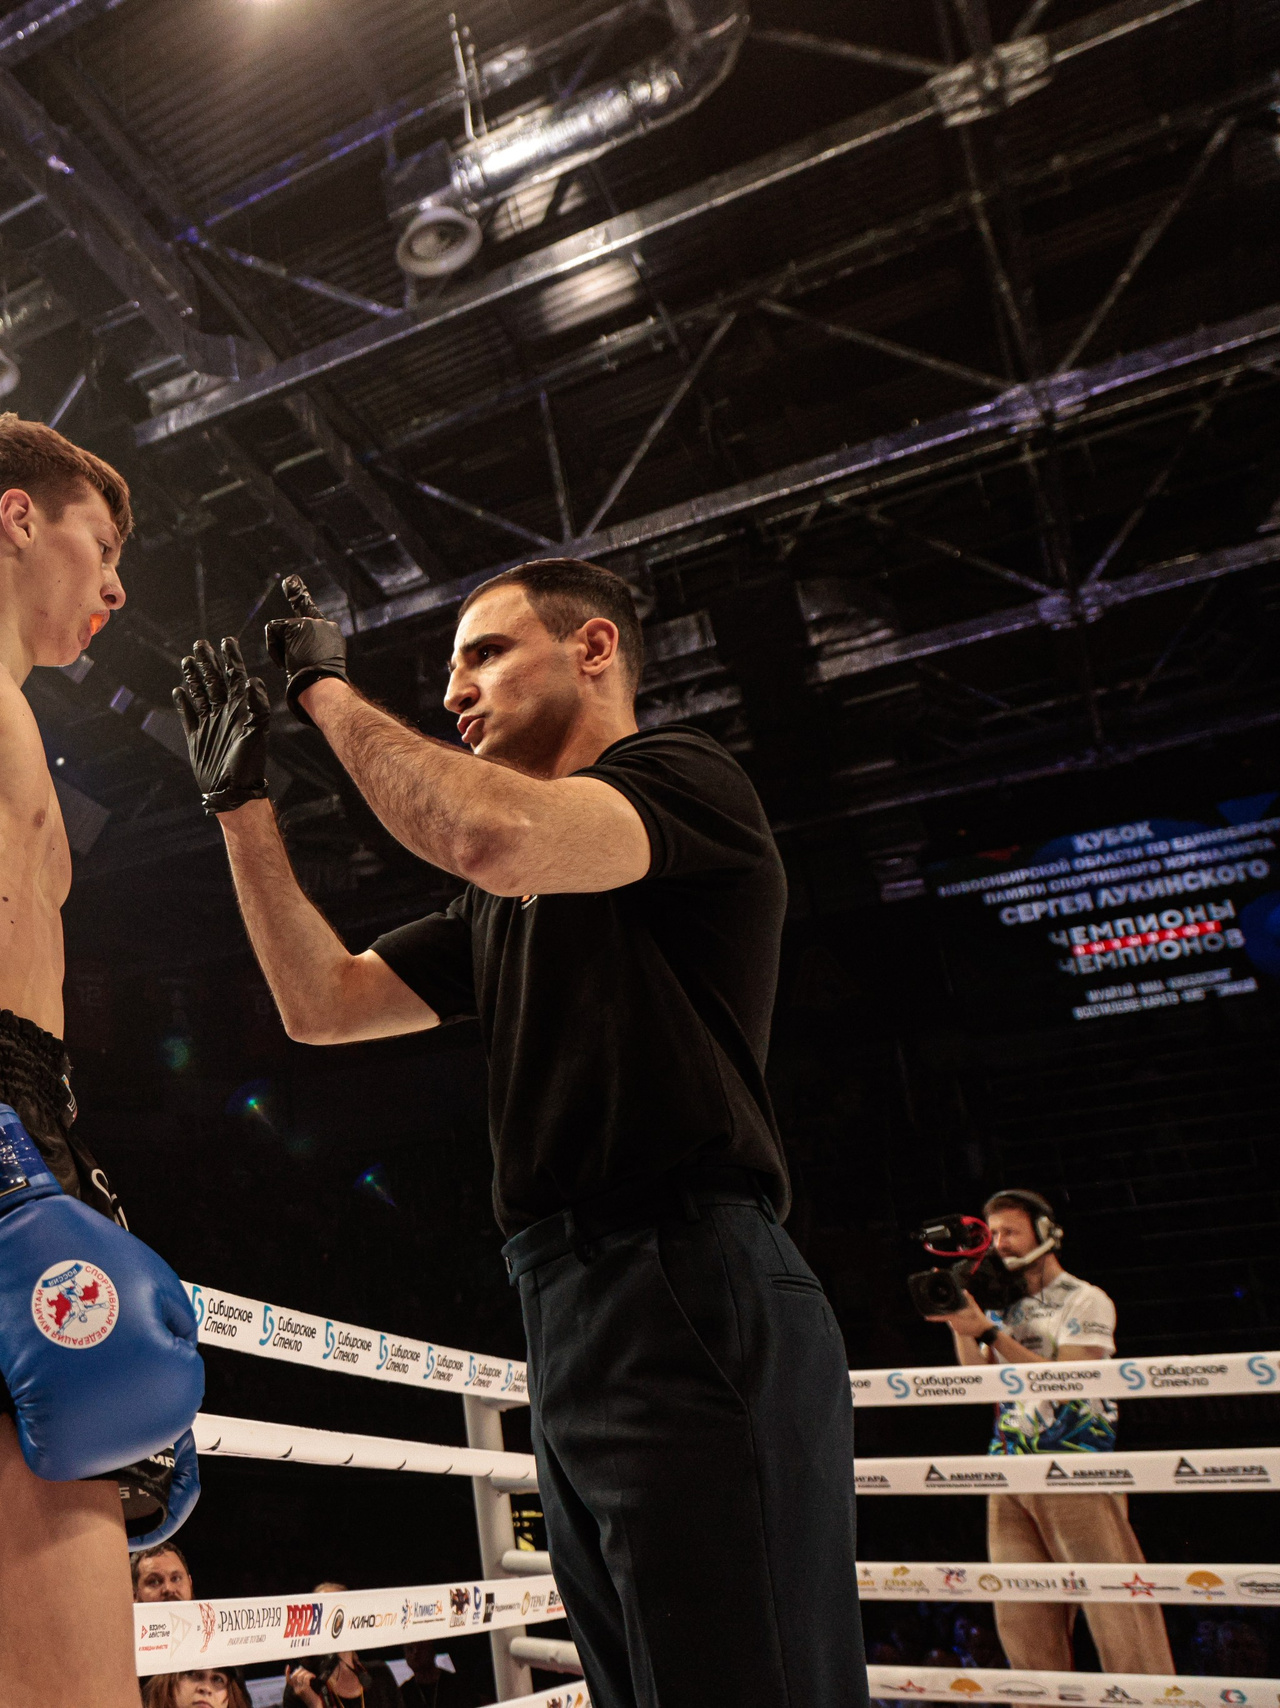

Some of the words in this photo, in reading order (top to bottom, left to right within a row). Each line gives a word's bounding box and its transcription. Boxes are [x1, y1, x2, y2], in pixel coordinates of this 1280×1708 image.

[1073, 821, 1154, 852] КУБОК
[1072, 846, 1144, 871] ОБЛАСТИ
[982, 882, 1047, 905] ПАМЯТИ
[999, 892, 1094, 925] СЕРГЕЯ
[1097, 859, 1270, 909] ЛУКИНСКОГО
[1048, 899, 1236, 948] ЧЕМПИОНЫ
[1058, 928, 1245, 976] ЧЕМПИОНОВ
[48, 1267, 78, 1287] РОССИЯ
[84, 1265, 117, 1326] СПОРТИВНАЯ
[208, 1298, 253, 1323] Сибирское
[51, 1325, 108, 1346] ФЕДЕРАЦИЯ
[204, 1316, 237, 1338] Стекло
[278, 1316, 317, 1339] Сибирское
[273, 1333, 303, 1352] Стекло
[338, 1331, 372, 1352] Сибирское
[333, 1346, 359, 1364] Стекло
[391, 1343, 420, 1362] Сибирское
[386, 1358, 409, 1374] Стекло
[437, 1354, 464, 1371] Сибирское
[1148, 1364, 1228, 1376] Сибирское
[432, 1368, 454, 1382] Стекло
[913, 1375, 982, 1386] Сибирское
[1027, 1370, 1101, 1382] Сибирское
[1151, 1377, 1209, 1388] Стекло
[916, 1387, 966, 1397] Стекло
[1030, 1382, 1084, 1392] Стекло
[950, 1472, 1008, 1481] АВАНГАРД
[1073, 1469, 1133, 1479] АВАНГАРД
[220, 1607, 281, 1632] РАКОВАРНЯ
